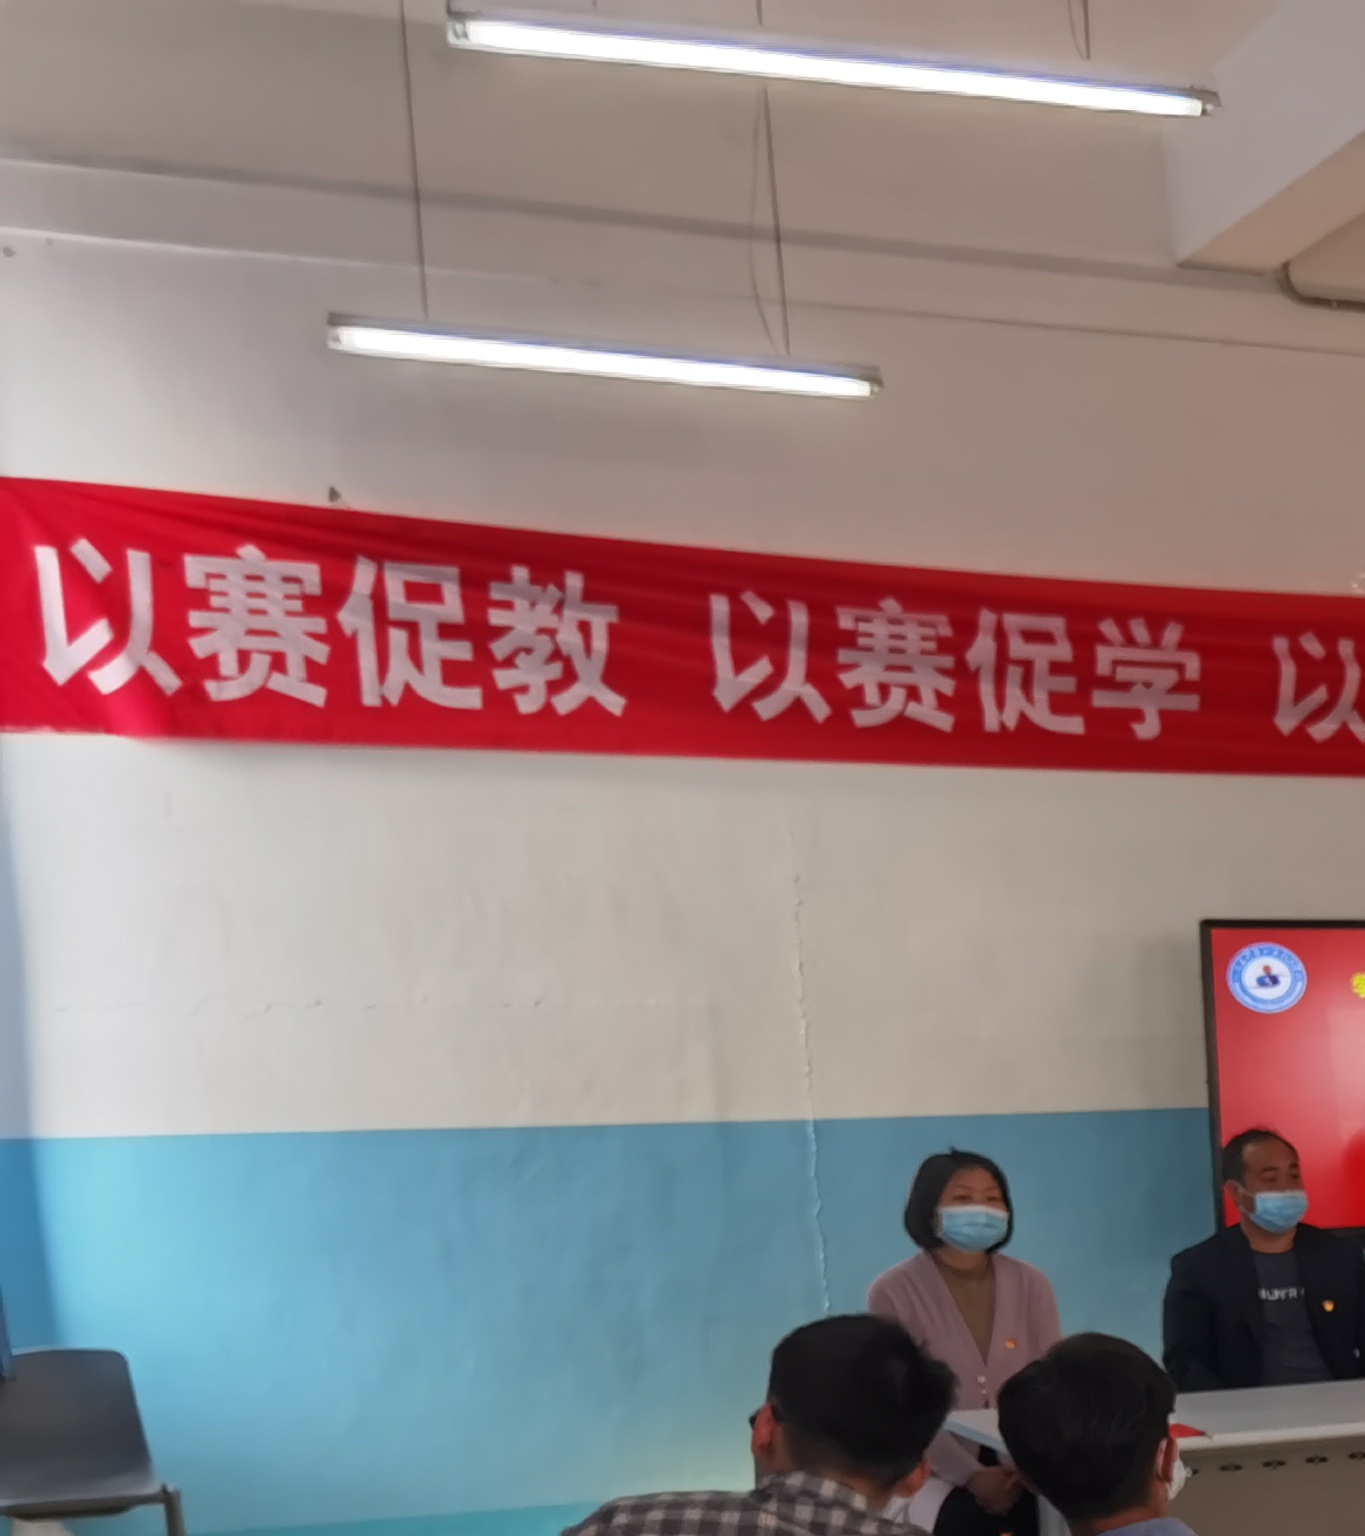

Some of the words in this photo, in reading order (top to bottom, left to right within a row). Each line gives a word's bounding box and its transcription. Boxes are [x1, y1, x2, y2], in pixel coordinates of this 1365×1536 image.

[34, 537, 626, 718] 以赛促教
[709, 589, 1202, 741] 以赛促学
